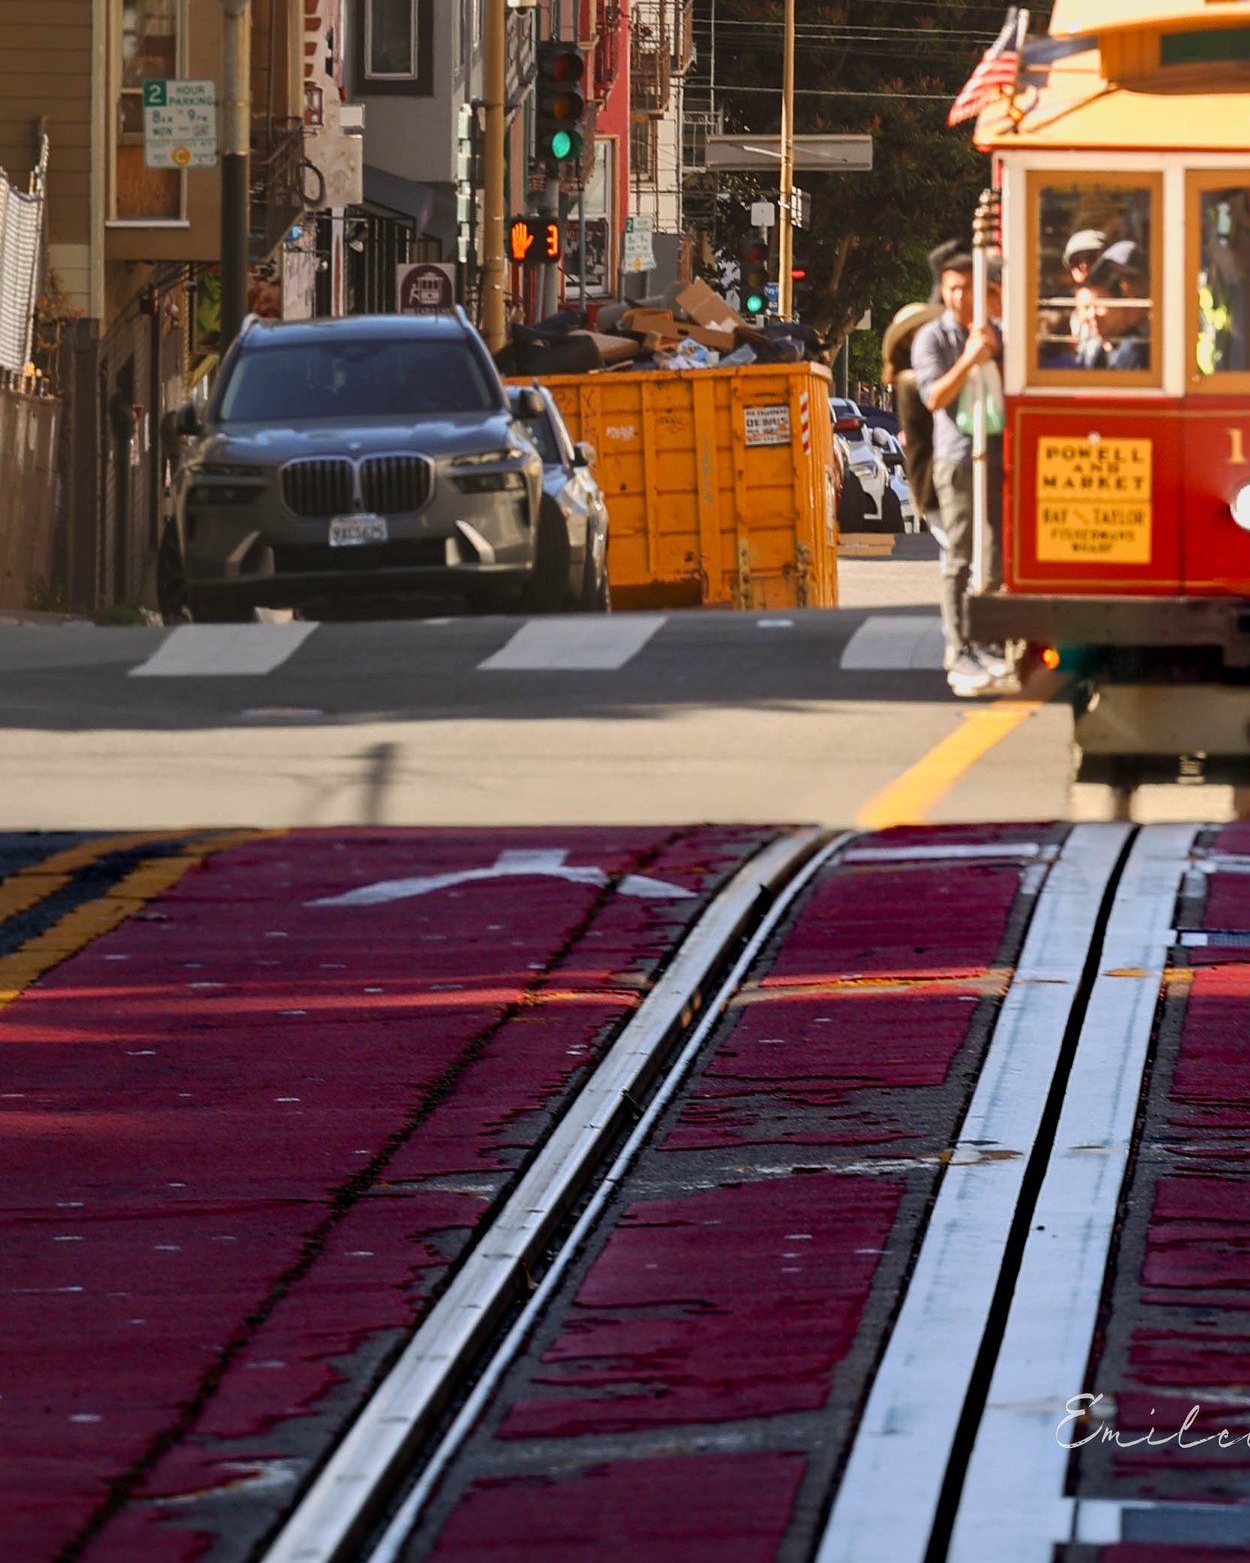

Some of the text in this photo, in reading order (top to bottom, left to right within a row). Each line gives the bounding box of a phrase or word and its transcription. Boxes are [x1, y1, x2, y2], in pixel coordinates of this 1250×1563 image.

[148, 83, 162, 103] 2
[176, 85, 205, 95] HOUR
[168, 96, 215, 106] PARKING
[546, 223, 559, 257] 3
[1045, 445, 1145, 463] POWELL
[1072, 462, 1121, 474] AND
[1042, 475, 1145, 491] MARKET
[1043, 509, 1145, 526] BAY TAYLOR
